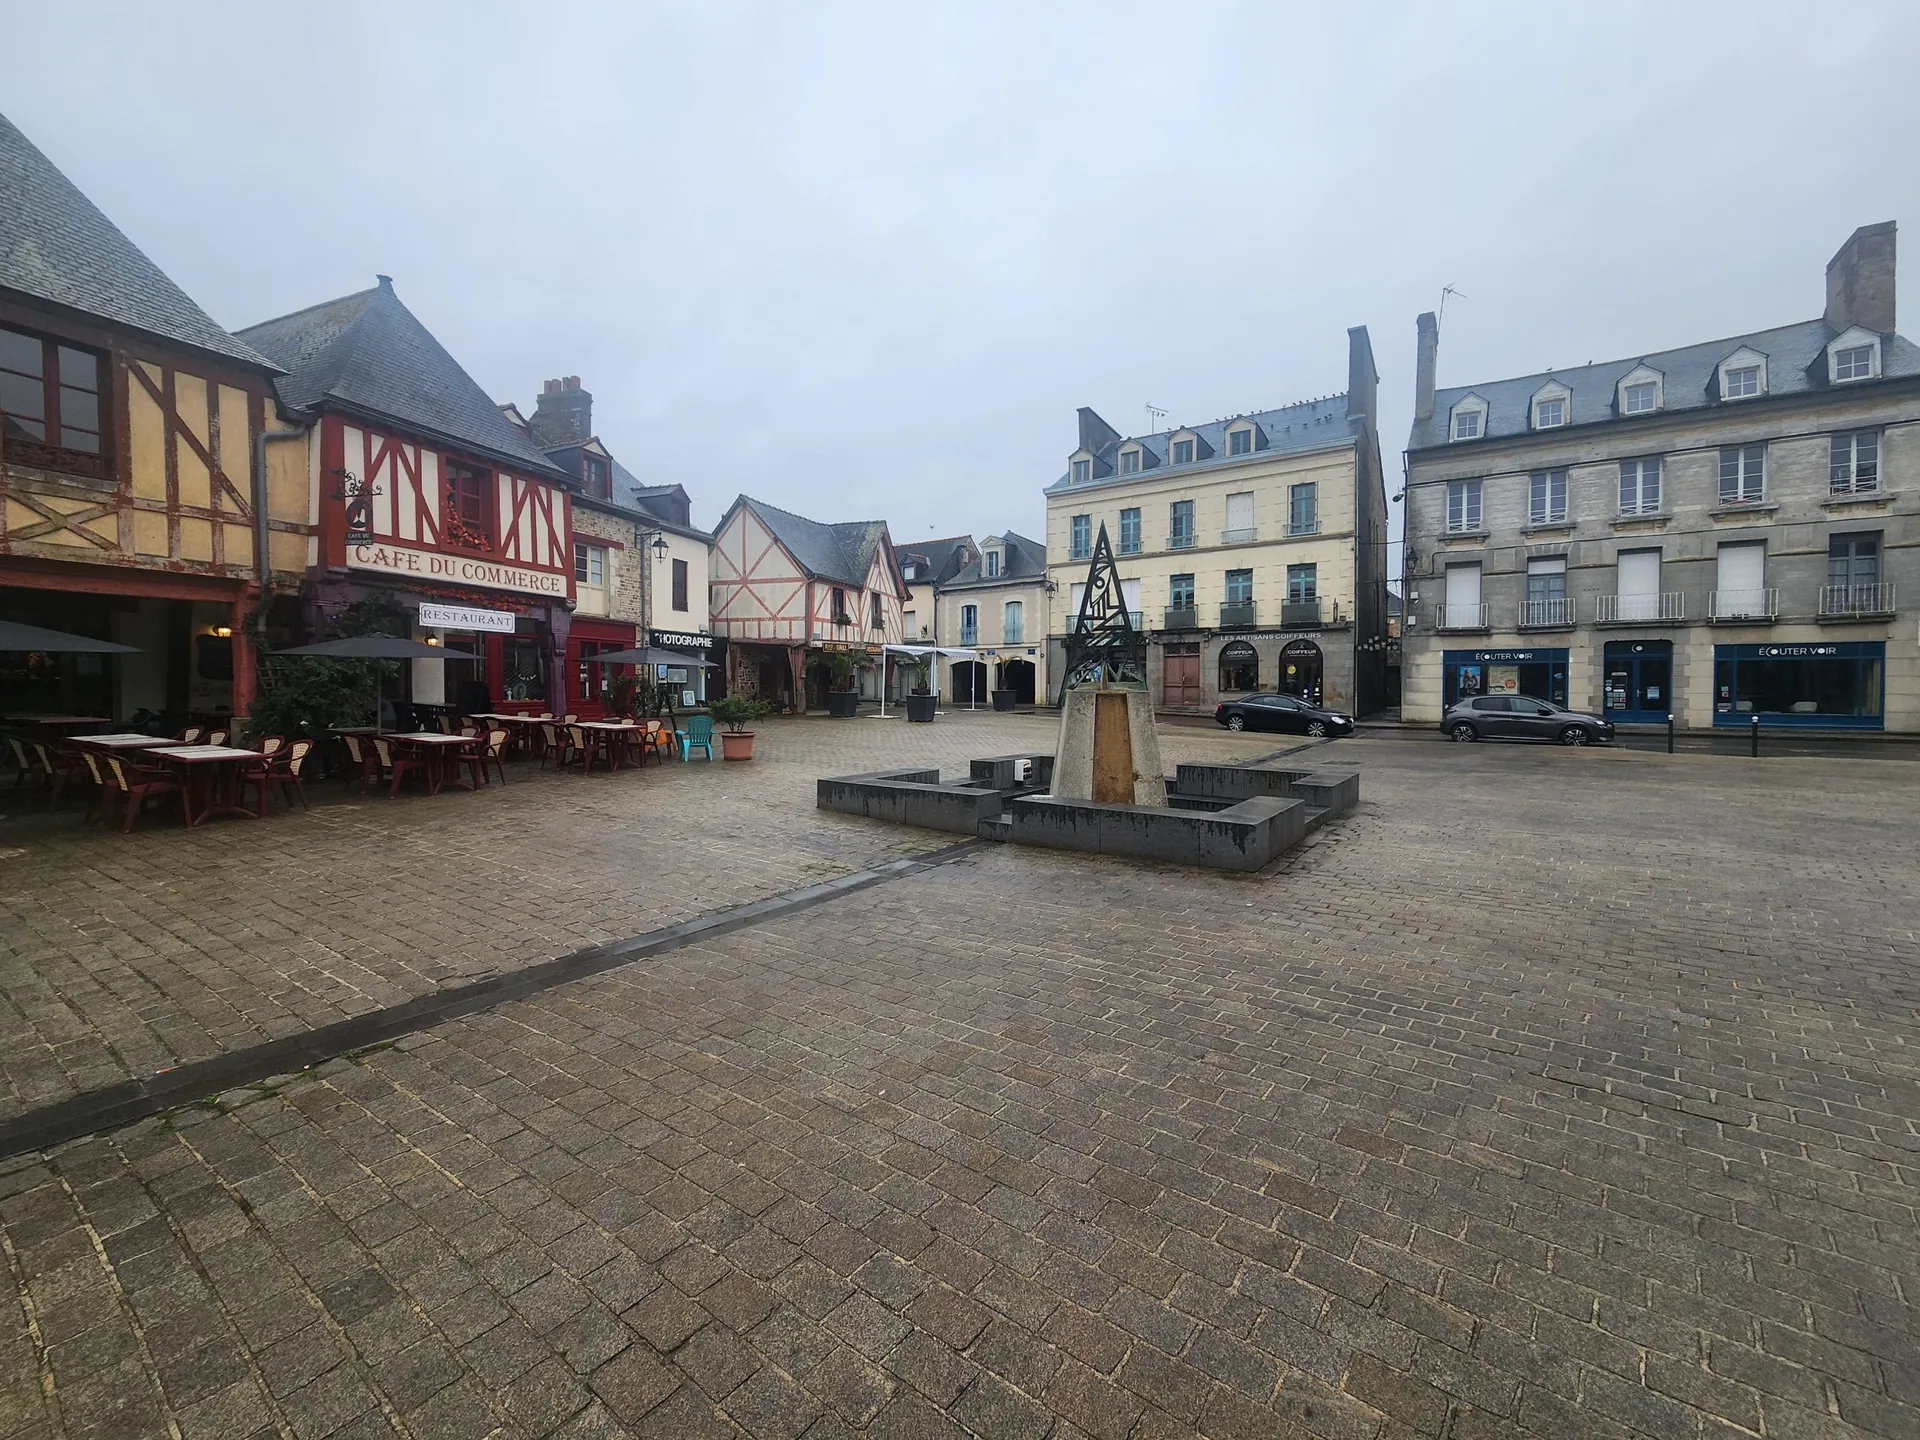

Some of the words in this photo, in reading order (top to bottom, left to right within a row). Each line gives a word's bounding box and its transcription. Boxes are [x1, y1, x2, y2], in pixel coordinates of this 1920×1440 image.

[355, 544, 422, 572] CAFE
[430, 557, 457, 576] DU
[462, 562, 561, 592] COMMERCE
[423, 609, 512, 627] RESTAURANT
[1236, 633, 1274, 641] ARTISANS
[1275, 632, 1322, 640] COIFFEURS
[1513, 652, 1533, 660] VOIR
[1758, 646, 1807, 657] ÉCOUTER
[1810, 647, 1836, 655] VOIR
